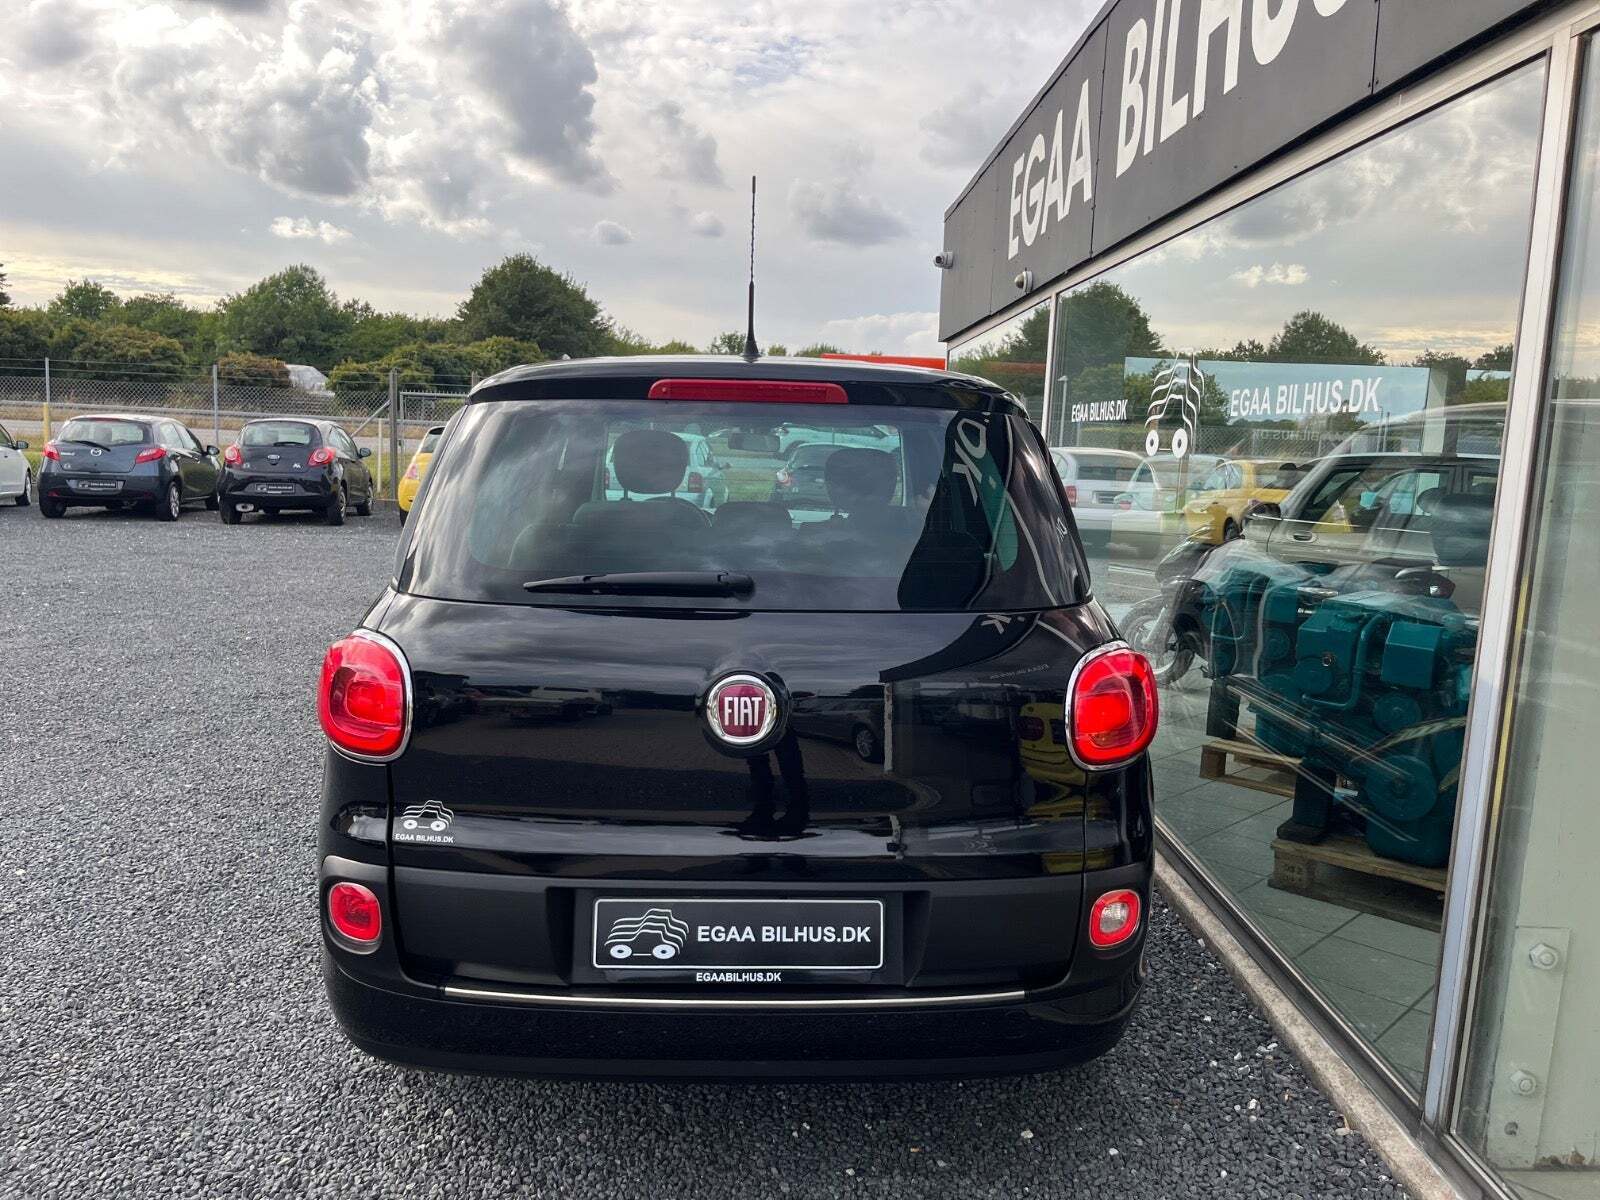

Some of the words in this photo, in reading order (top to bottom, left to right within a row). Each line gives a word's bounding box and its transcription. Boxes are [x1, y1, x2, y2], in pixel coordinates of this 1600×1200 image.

[1007, 79, 1093, 260] EGAA
[1231, 386, 1271, 416] EGAA
[1276, 377, 1383, 414] BILHUS.DK
[1072, 403, 1088, 422] EGAA
[1090, 399, 1128, 421] BILHUS.DK
[724, 697, 762, 726] FIAT
[395, 833, 415, 841] EGAA
[416, 834, 454, 843] BILHUS.DK
[697, 925, 755, 942] EGAA
[762, 926, 871, 943] BILHUS.DK
[696, 973, 782, 982] EGAABILHUS.DK
